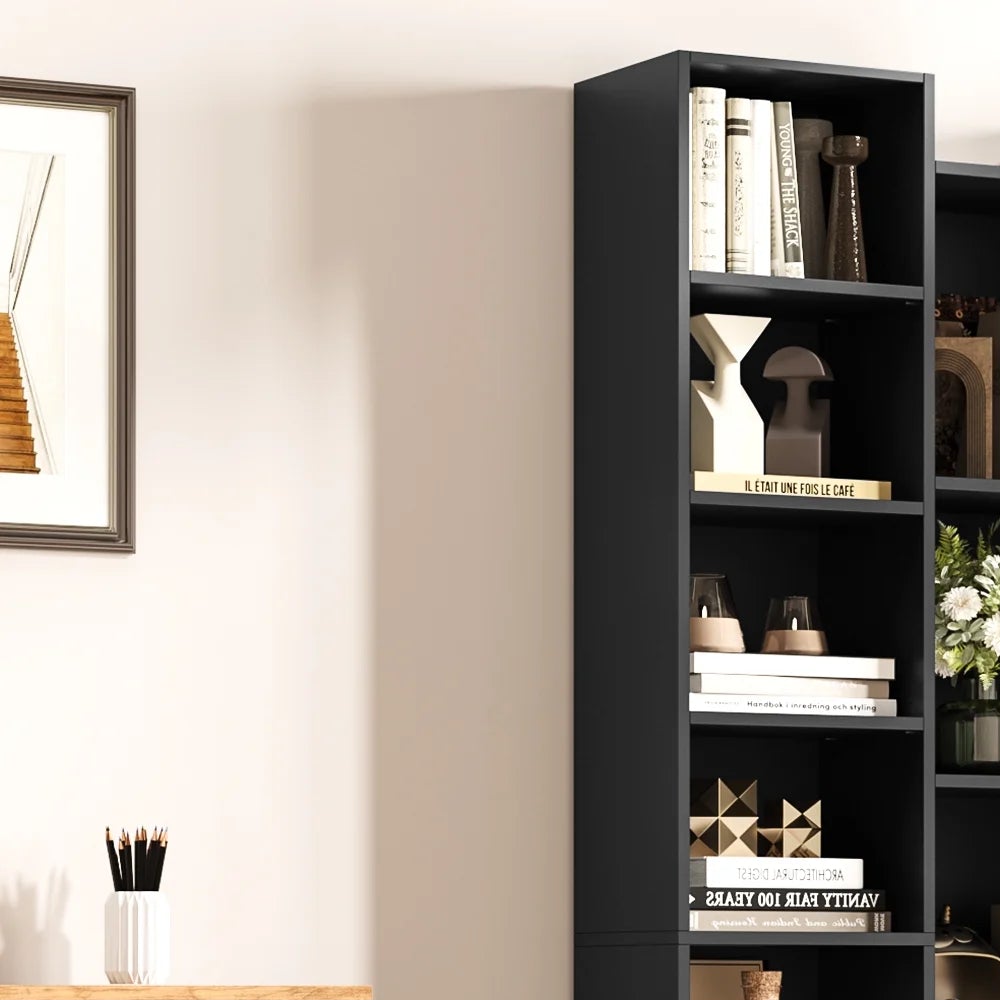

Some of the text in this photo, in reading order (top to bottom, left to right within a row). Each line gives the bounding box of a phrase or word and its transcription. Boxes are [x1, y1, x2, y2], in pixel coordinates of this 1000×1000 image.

[778, 122, 793, 168] YOUNG
[781, 178, 799, 248] THE SHACK
[745, 479, 855, 497] IL ÉTAIT UNE FOIS LE CAFÉ
[747, 701, 784, 709] Handbok
[791, 702, 830, 712] inredning
[849, 703, 877, 713] styling
